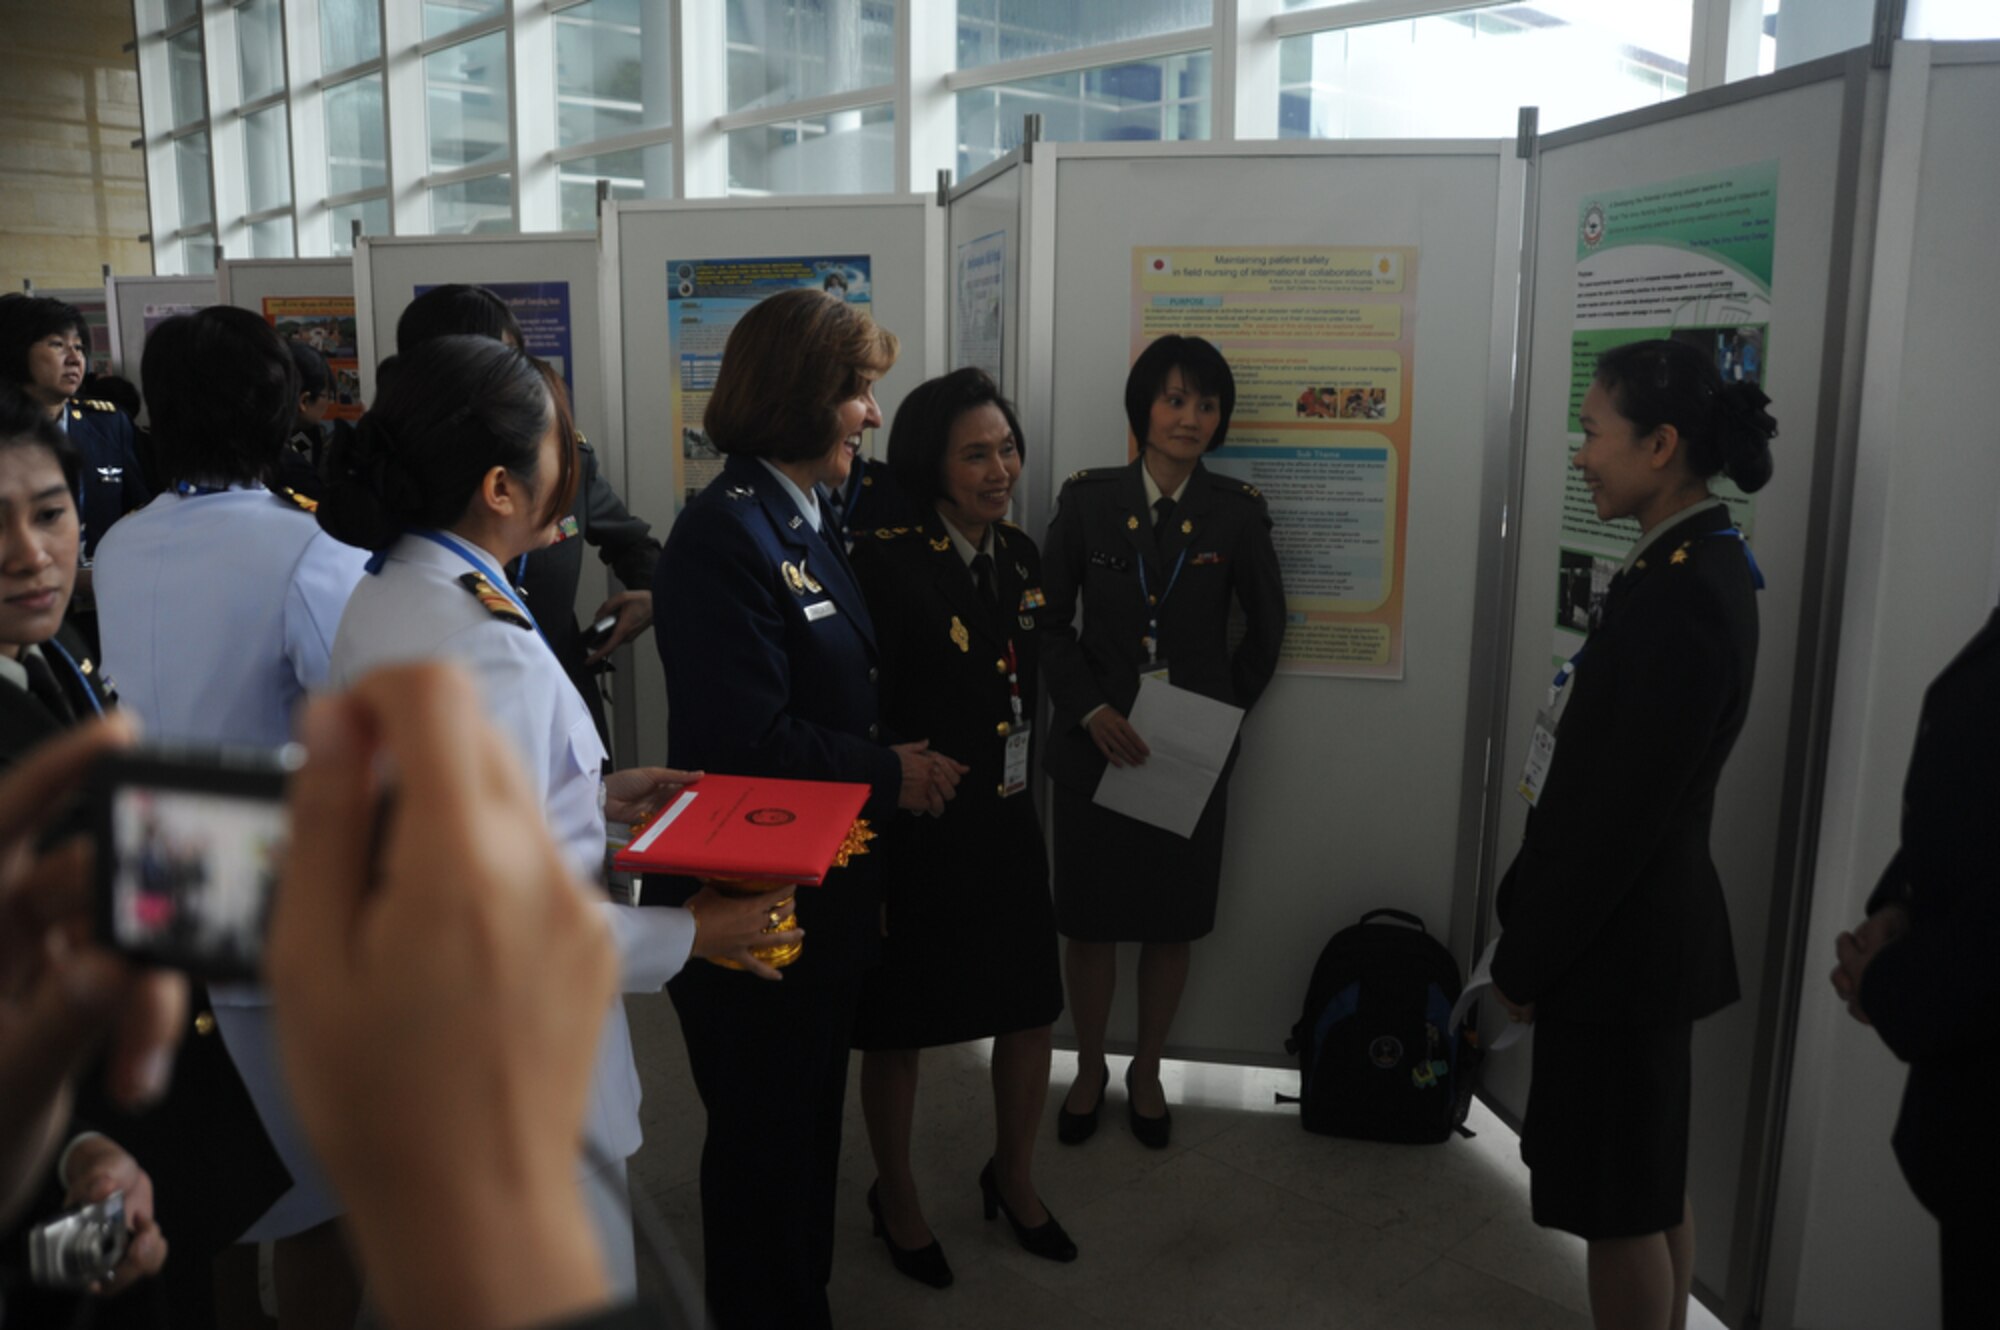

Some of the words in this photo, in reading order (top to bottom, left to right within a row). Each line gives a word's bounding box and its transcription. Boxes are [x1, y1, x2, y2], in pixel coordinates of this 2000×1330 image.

[1215, 255, 1266, 266] Maintaining
[1268, 255, 1299, 266] patient
[1302, 255, 1329, 266] safety
[1173, 268, 1181, 277] in
[1183, 268, 1202, 277] field
[1204, 268, 1237, 279] nursing
[1240, 268, 1250, 277] of
[1251, 268, 1306, 278] international
[1308, 268, 1373, 277] collaborations
[1170, 298, 1204, 306] PURPOSE
[1296, 449, 1312, 458] Sub
[1314, 449, 1341, 458] Theme
